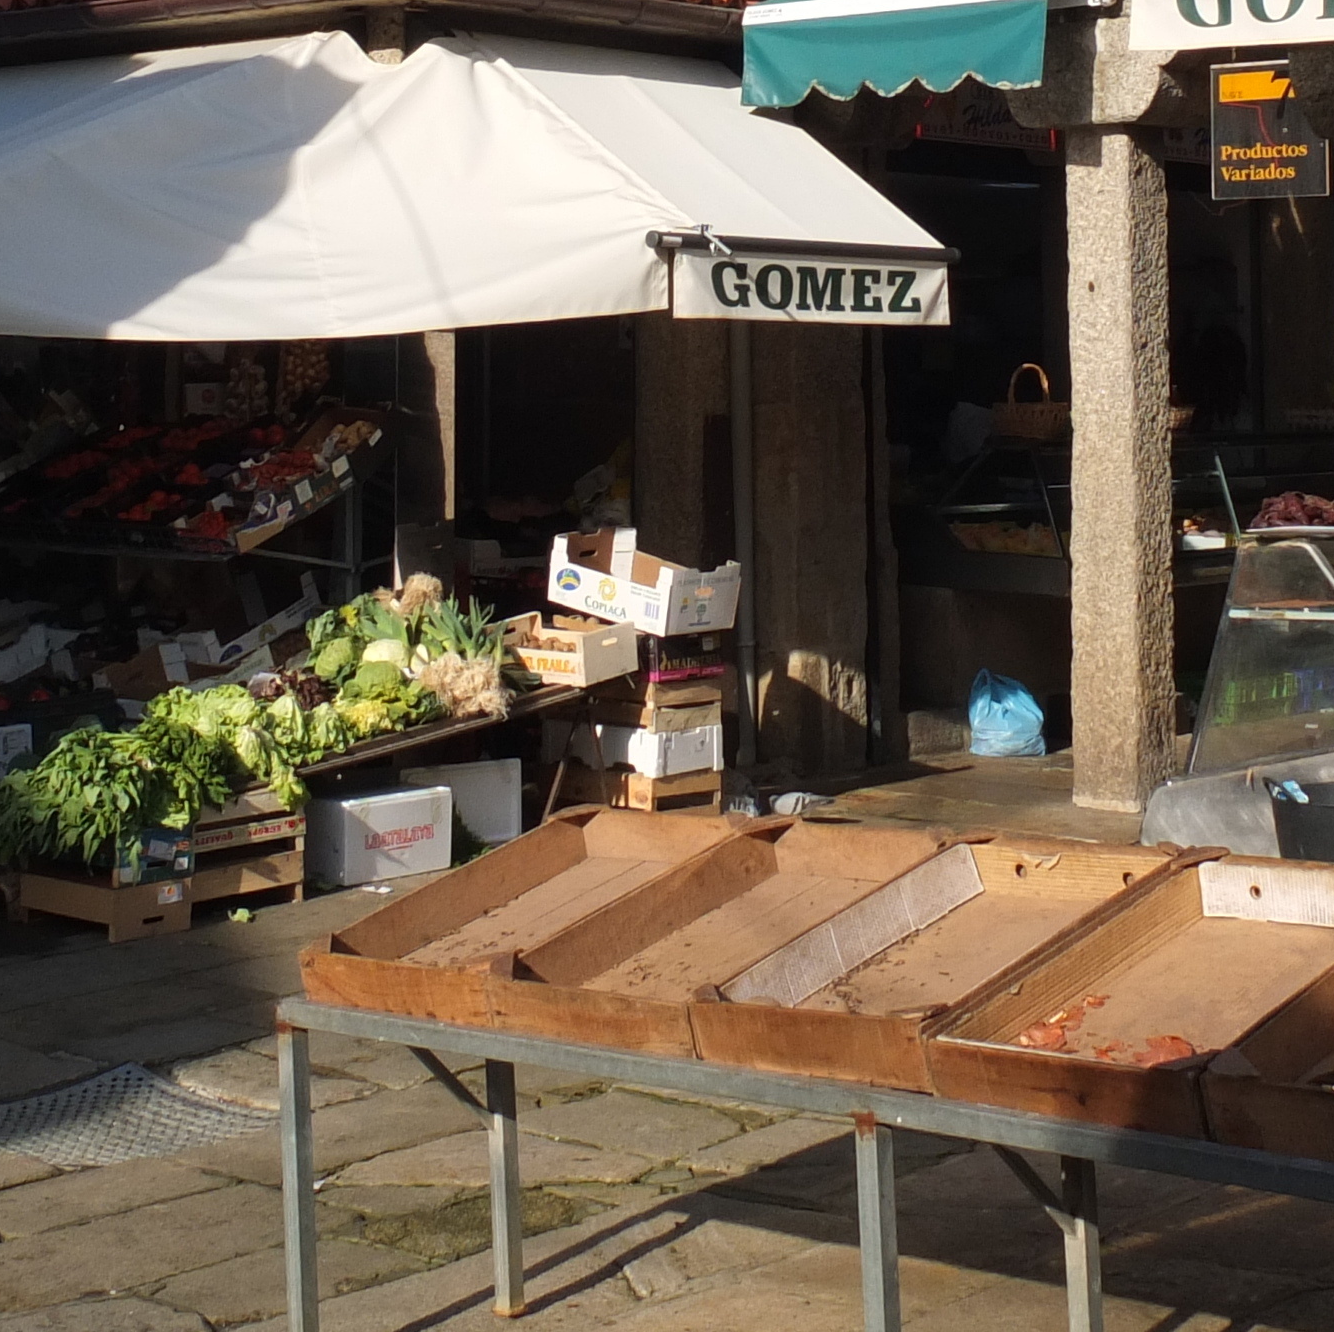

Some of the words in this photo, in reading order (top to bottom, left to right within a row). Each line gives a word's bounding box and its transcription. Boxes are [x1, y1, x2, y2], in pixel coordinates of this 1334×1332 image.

[1220, 142, 1308, 161] Productos
[1220, 162, 1296, 182] Variados
[711, 260, 922, 313] GOMEZ
